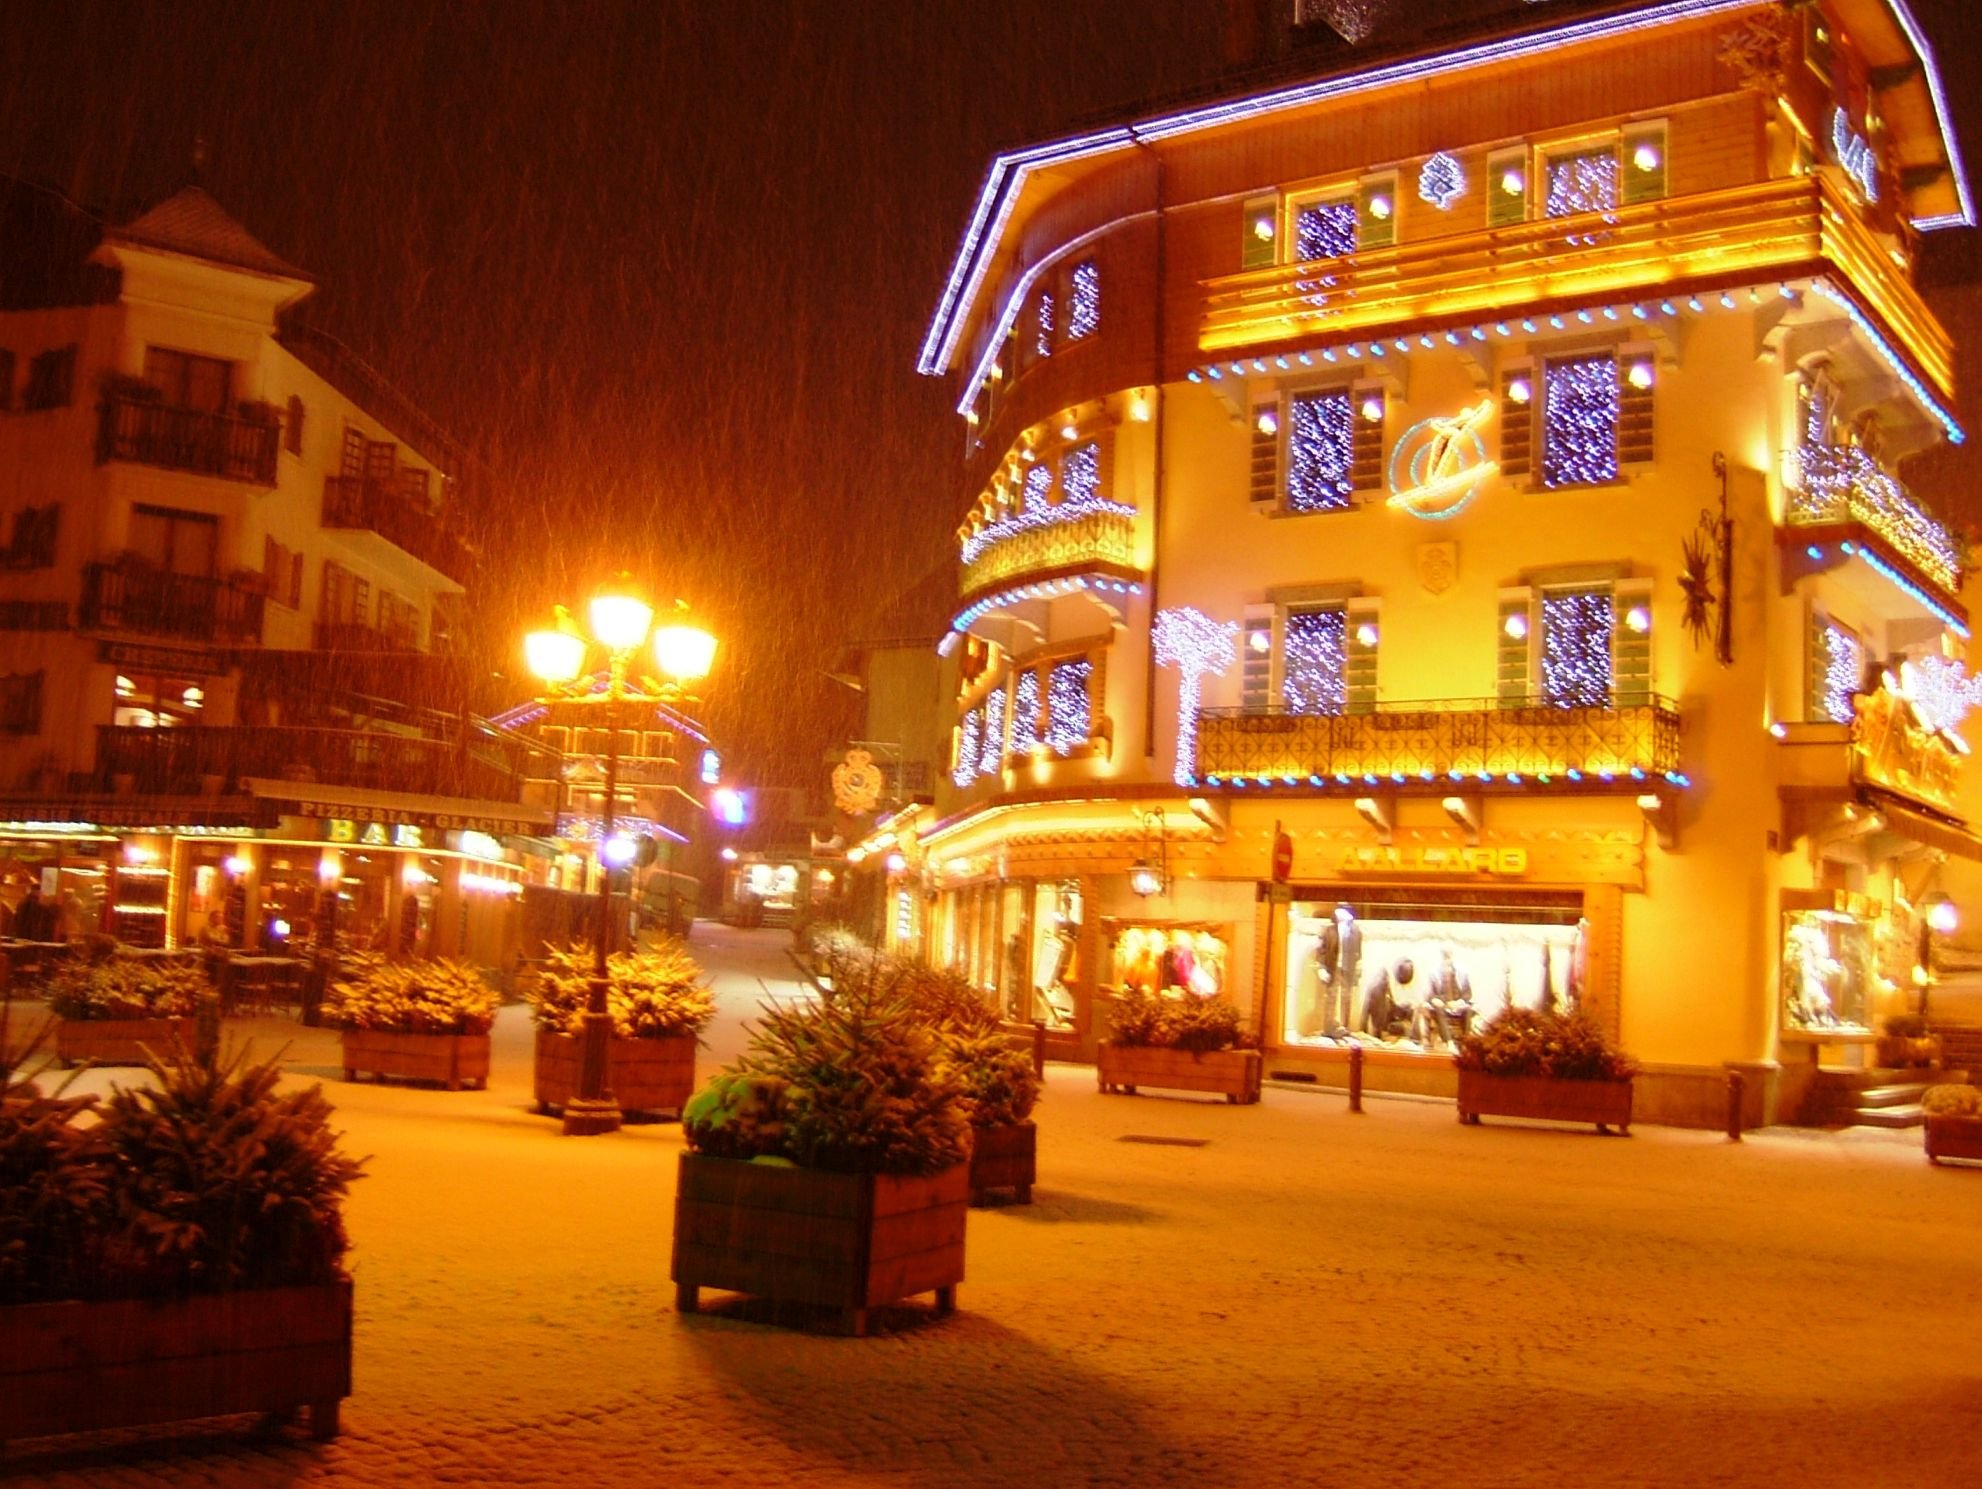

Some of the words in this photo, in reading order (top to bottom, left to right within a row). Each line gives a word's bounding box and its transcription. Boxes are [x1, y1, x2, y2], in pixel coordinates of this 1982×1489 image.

[301, 802, 410, 825] PIZZERIA
[435, 814, 532, 836] GLACIER
[328, 818, 424, 848] BAR
[1337, 847, 1528, 873] AALLARD
